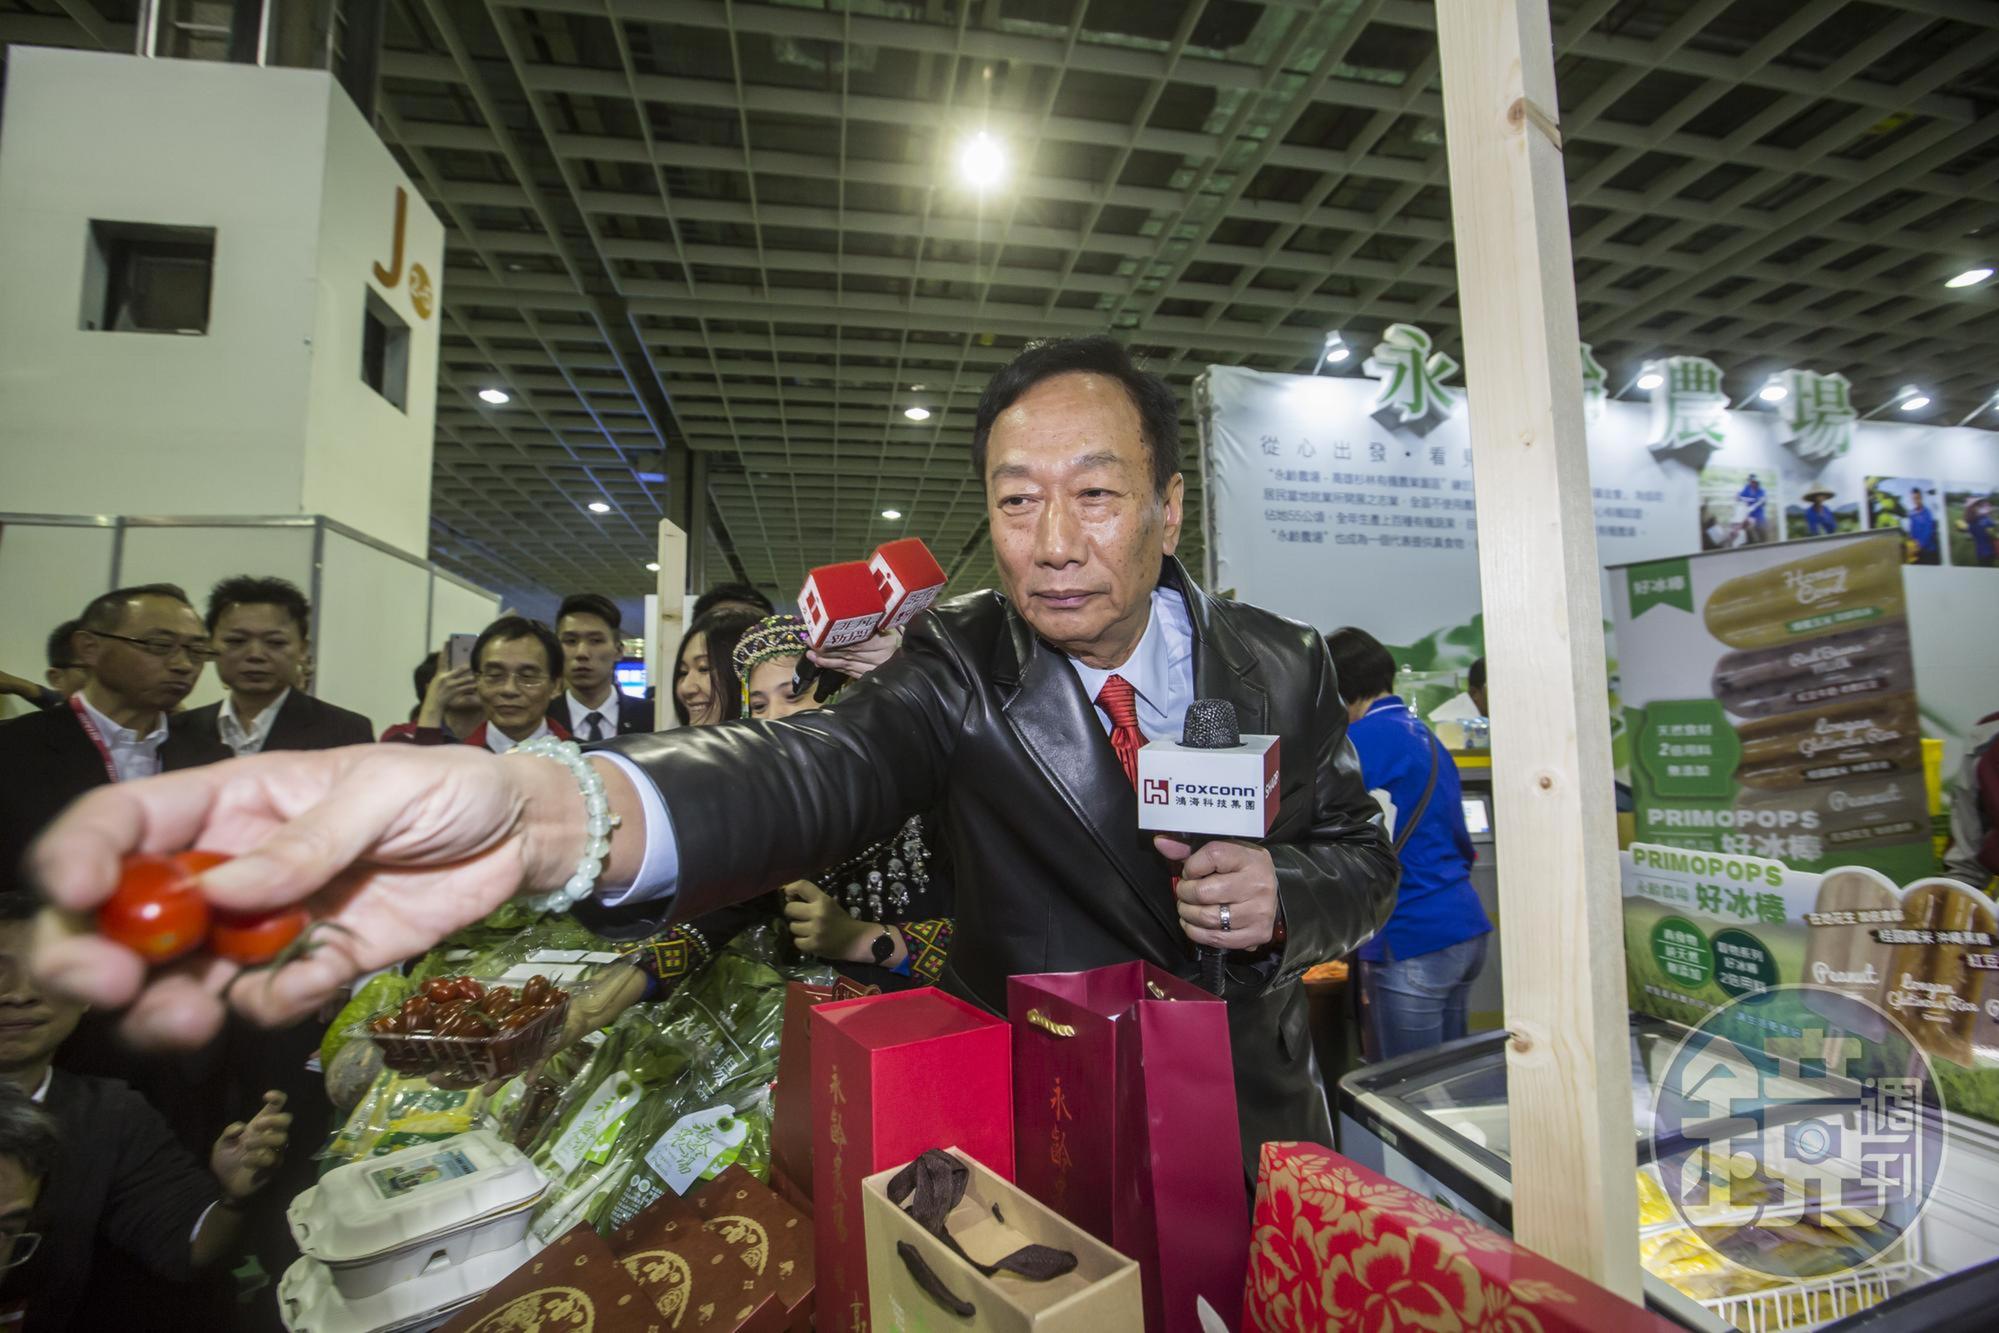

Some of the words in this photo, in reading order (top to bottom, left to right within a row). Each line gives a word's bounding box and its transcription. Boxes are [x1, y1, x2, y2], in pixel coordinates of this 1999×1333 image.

[374, 186, 408, 288] J
[1175, 796, 1256, 811] 鴻海科技集團
[1647, 808, 1821, 829] PRIMOPOPS
[1720, 832, 1824, 861] 好冰棒
[1633, 849, 1785, 887] PRIMOPOPS
[1695, 882, 1787, 925] 好冰棒
[1812, 961, 1880, 985] Peanut
